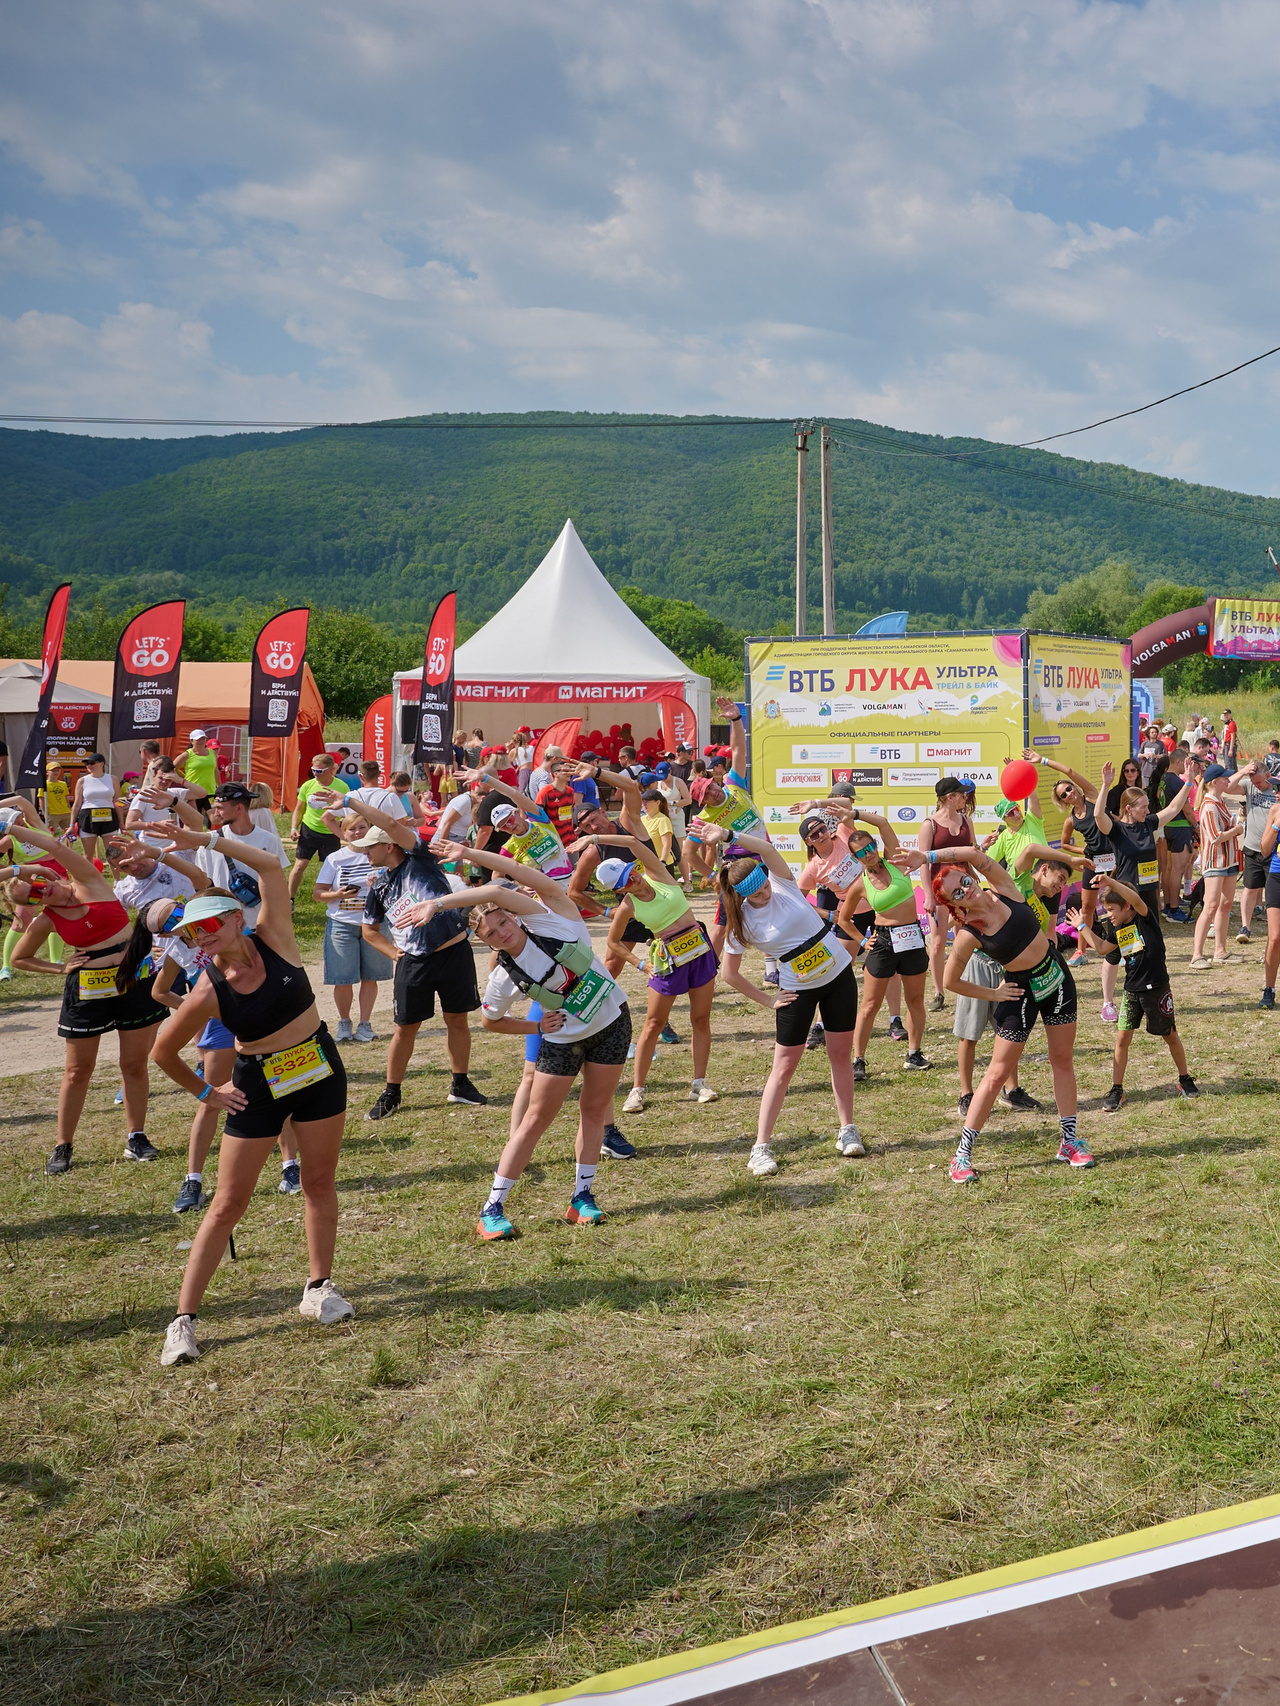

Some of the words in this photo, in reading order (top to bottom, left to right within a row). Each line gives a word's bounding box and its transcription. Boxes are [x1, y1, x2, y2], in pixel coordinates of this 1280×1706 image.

[1231, 611, 1252, 621] ВТБ
[1231, 625, 1274, 635] УЛЬТРА
[136, 637, 165, 648] LET'S
[269, 640, 292, 652] LET'S
[132, 649, 169, 667] GO
[266, 652, 294, 669] GO
[789, 669, 835, 693] ВТБ
[845, 667, 933, 692] ЛУКА
[936, 665, 998, 678] УЛЬТРА
[1043, 665, 1063, 688] ВТБ
[1067, 666, 1100, 689] ЛУКА
[1101, 668, 1122, 680] УЛЬТРА
[131, 688, 173, 696] ДЕЙСТВУЙ!
[936, 682, 964, 690] ТРЕЙЛ
[974, 681, 999, 690] БАЙК
[61, 721, 76, 729] GO
[880, 748, 901, 760] ВТБ
[391, 899, 411, 918] 1060
[897, 929, 918, 939] 1073
[1118, 931, 1134, 944] 069
[673, 935, 699, 953] 5067
[797, 950, 825, 971] 5070
[87, 975, 116, 985] 5101
[572, 980, 597, 1005] 1591
[269, 1057, 283, 1065] ВТБ
[284, 1047, 305, 1060] ЛУКА
[272, 1051, 318, 1076] 5322
